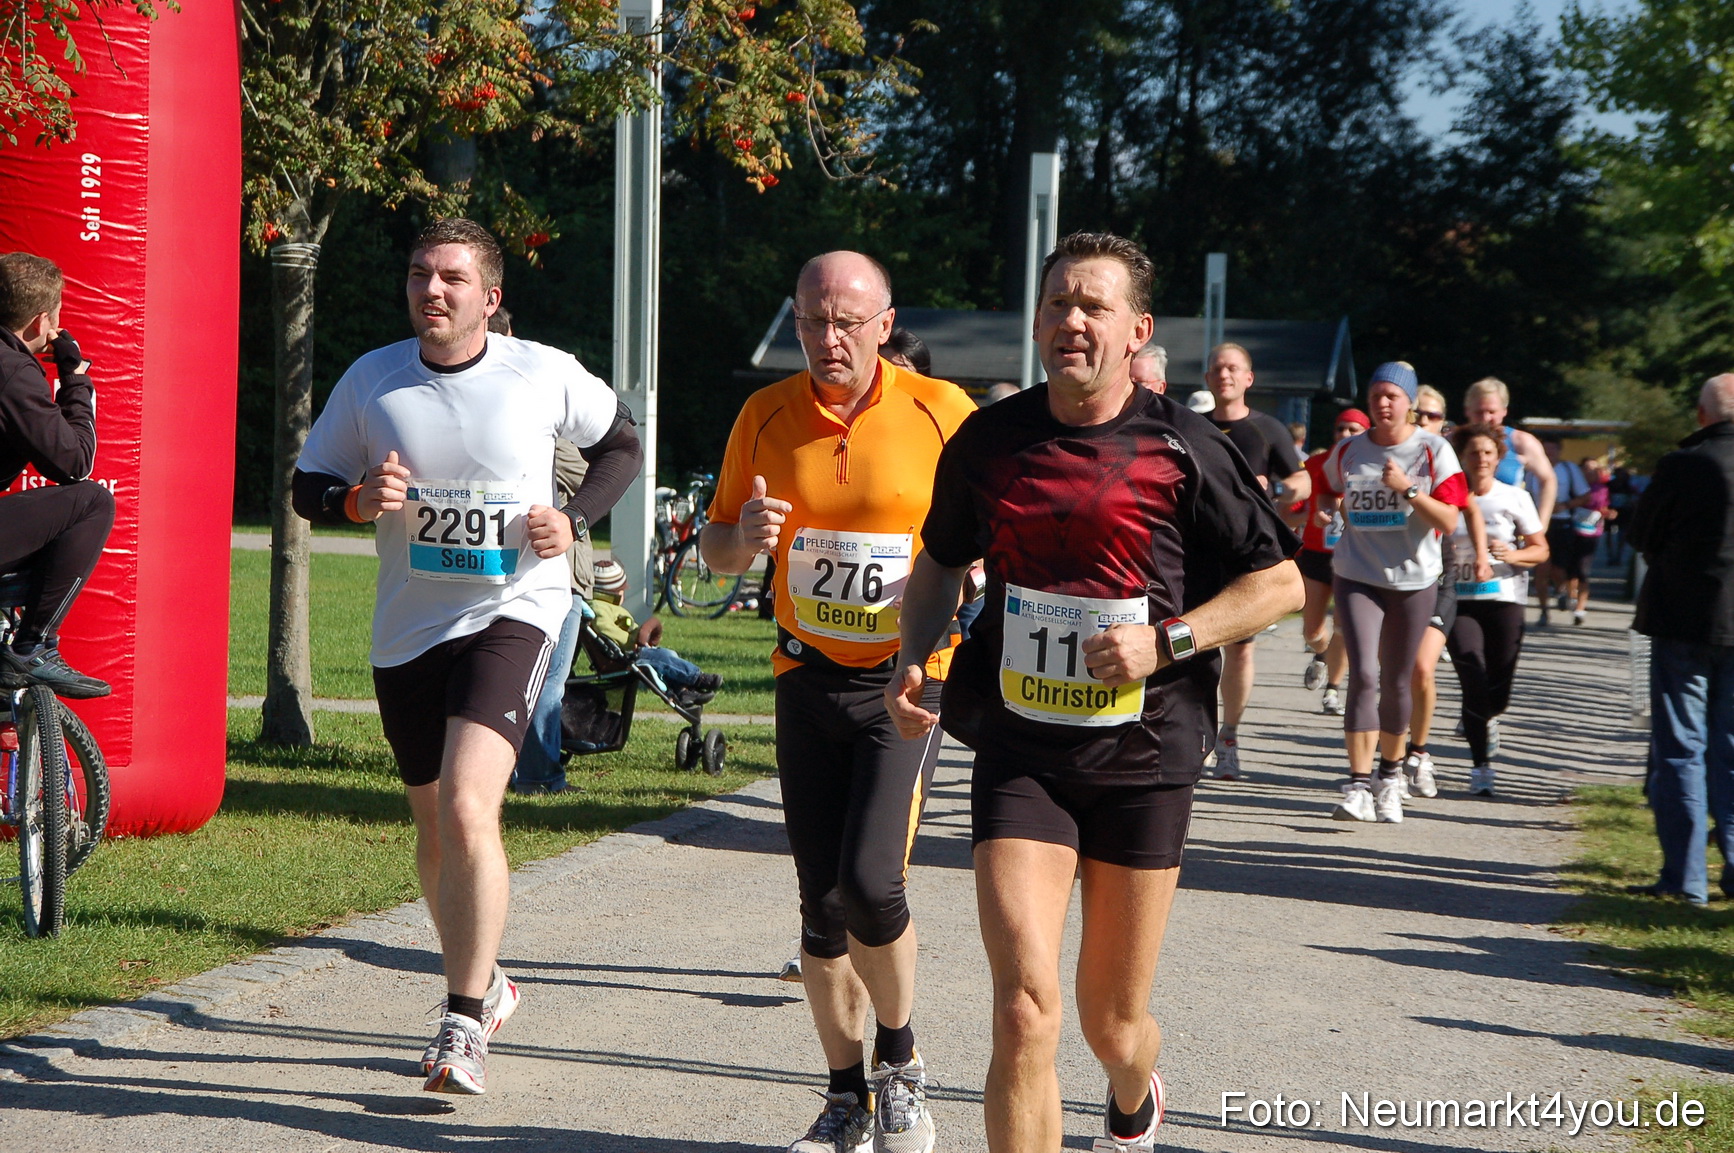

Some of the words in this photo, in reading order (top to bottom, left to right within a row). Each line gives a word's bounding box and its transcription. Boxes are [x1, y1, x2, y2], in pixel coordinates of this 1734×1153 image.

[81, 153, 102, 198] 1929
[80, 206, 100, 242] Seit
[22, 469, 47, 491] ist
[421, 488, 471, 499] PFLEIDERER
[1350, 490, 1399, 510] 2564
[417, 506, 505, 546] 2291
[1354, 512, 1398, 524] Susanne
[806, 538, 858, 552] PFLEIDERER
[441, 548, 485, 570] Sebi
[812, 558, 883, 603] 276
[816, 601, 878, 633] Georg
[1021, 600, 1082, 620] PFLEIDERER
[1029, 626, 1097, 680] 11
[1021, 675, 1119, 708] Christof
